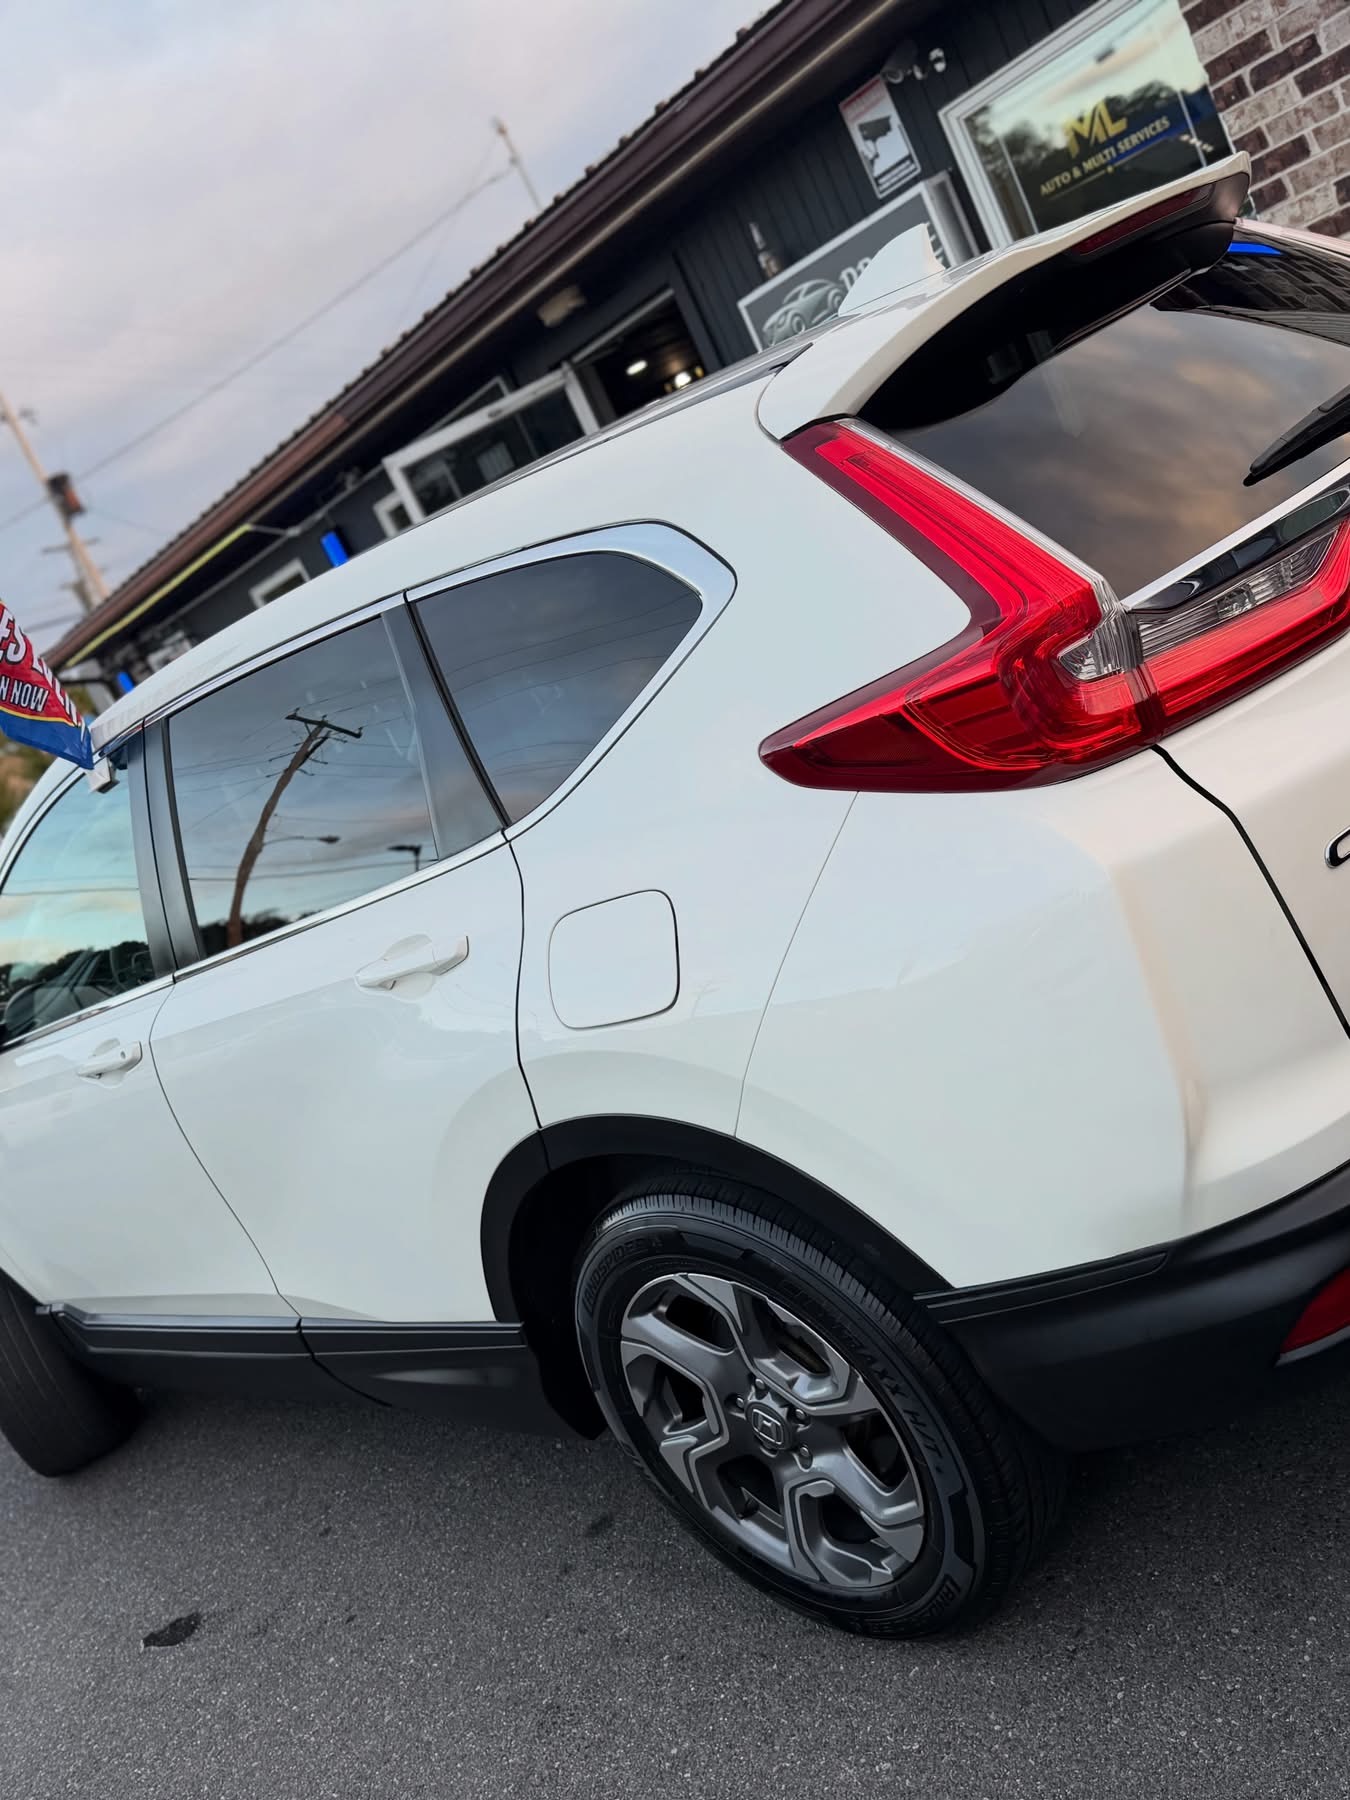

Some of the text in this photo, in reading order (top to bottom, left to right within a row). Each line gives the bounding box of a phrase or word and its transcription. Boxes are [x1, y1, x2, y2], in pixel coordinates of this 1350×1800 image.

[1040, 171, 1073, 197] AUTO
[1082, 145, 1118, 174] MULTI
[1117, 115, 1171, 154] SERVICES
[1063, 100, 1128, 159] ML
[10, 679, 49, 712] NOW
